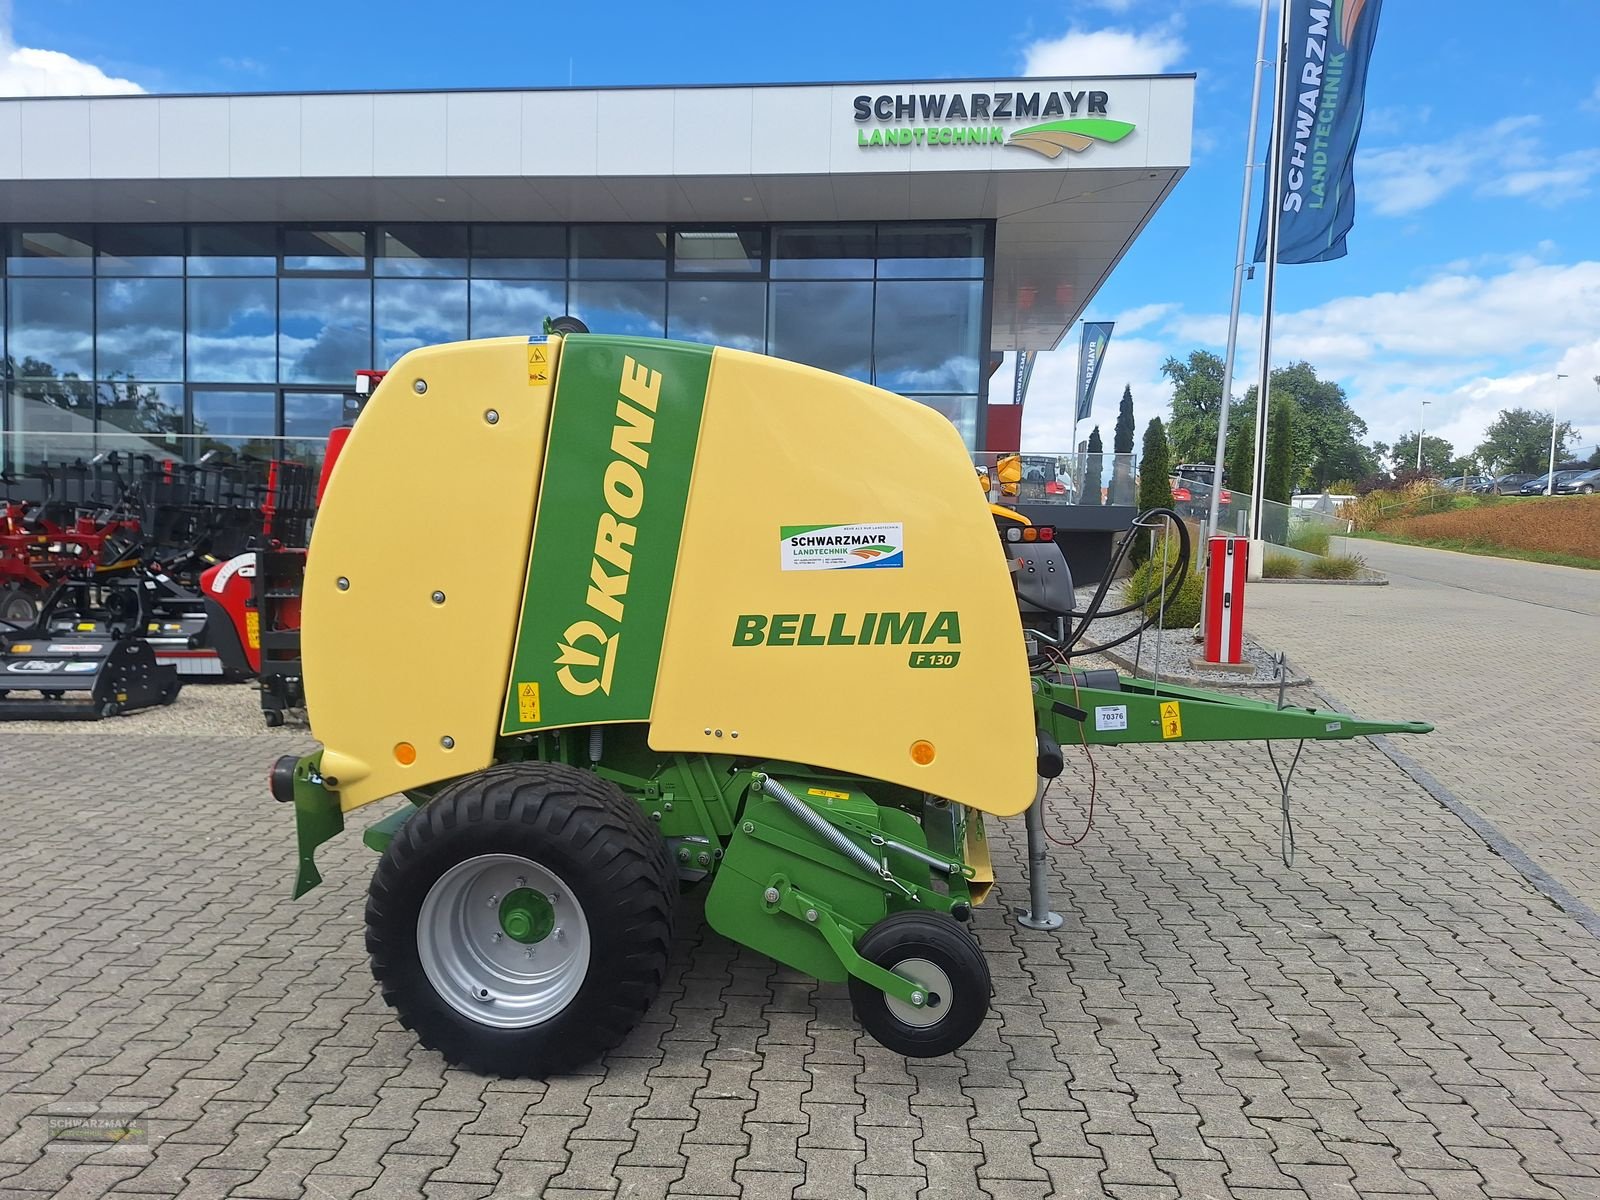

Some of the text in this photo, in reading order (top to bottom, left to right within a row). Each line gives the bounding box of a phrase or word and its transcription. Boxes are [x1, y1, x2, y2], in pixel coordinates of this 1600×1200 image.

[853, 89, 1109, 121] SCHWARZMAYR
[857, 126, 1004, 147] LANDTECHNIK
[1308, 51, 1346, 209] LANDTECHNIK
[585, 354, 663, 624] KRONE
[791, 534, 886, 547] SCHWARZMAYR
[793, 547, 848, 556] LANDTECHNIK
[732, 611, 961, 647] BELLIMA
[916, 654, 953, 666] F 130
